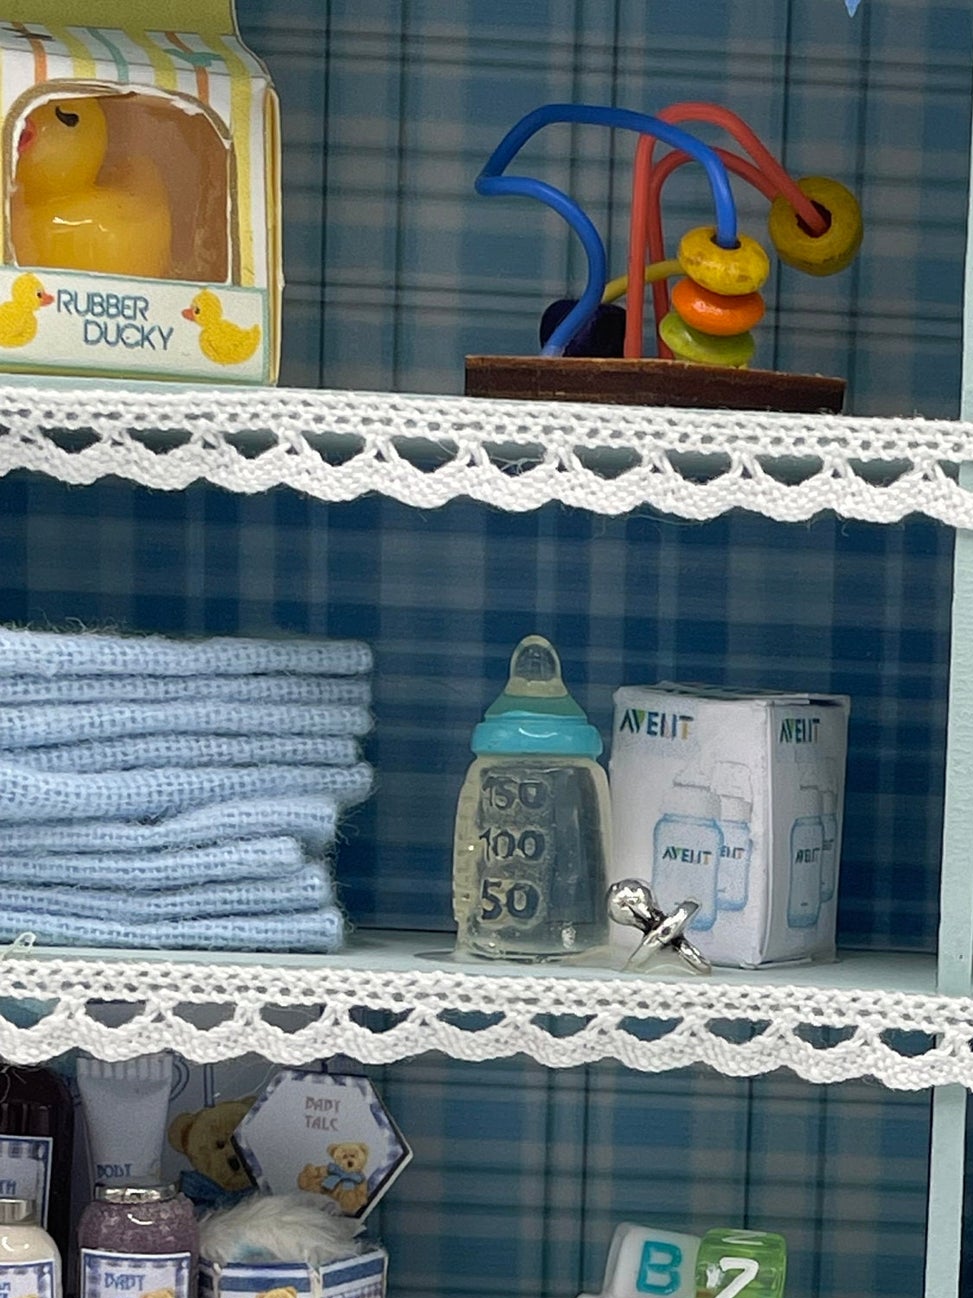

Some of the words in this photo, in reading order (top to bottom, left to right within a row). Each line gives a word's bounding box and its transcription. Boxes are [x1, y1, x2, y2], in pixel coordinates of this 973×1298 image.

[57, 289, 149, 321] RUBBER
[83, 319, 174, 350] DUCKY
[482, 776, 549, 809] 150
[479, 828, 546, 861] 100
[481, 879, 540, 920] 50
[305, 1115, 338, 1131] TALC
[635, 1240, 682, 1295] B
